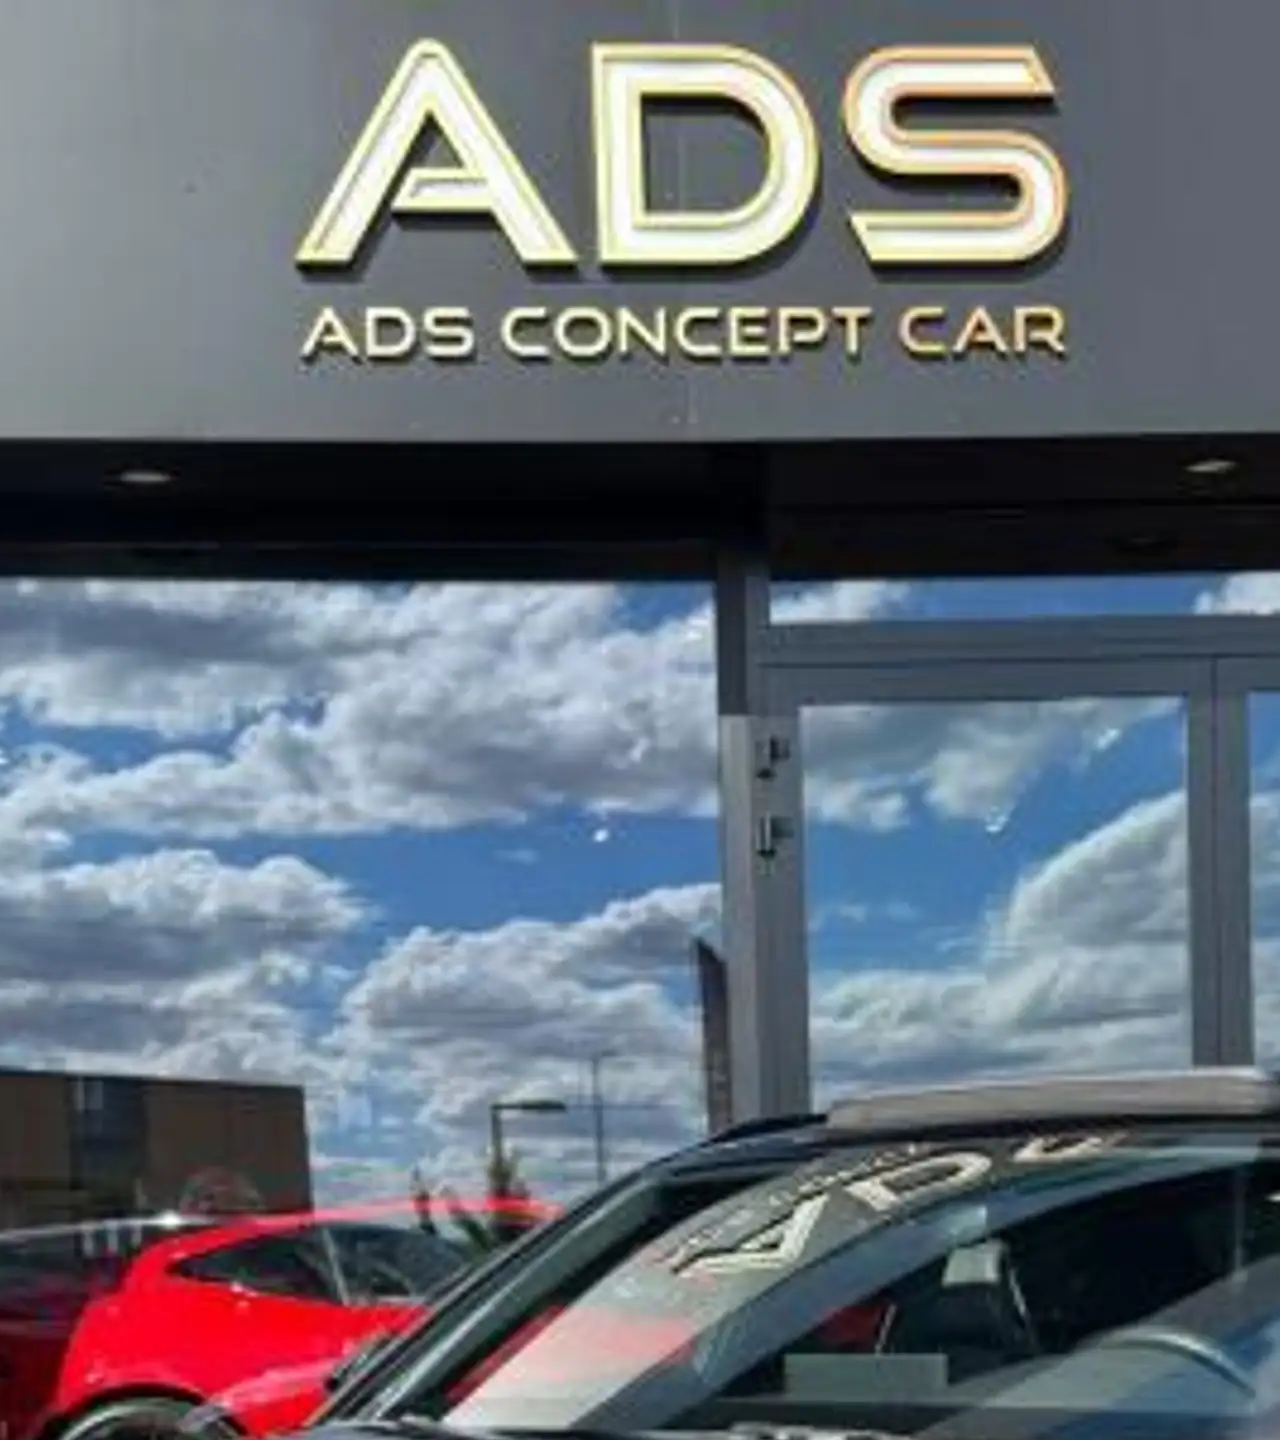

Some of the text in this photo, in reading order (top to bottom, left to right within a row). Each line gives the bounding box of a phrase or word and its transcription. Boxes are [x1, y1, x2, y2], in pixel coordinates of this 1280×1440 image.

[296, 38, 1069, 266] ADS
[301, 305, 1066, 358] ADS CONCEPT CAR
